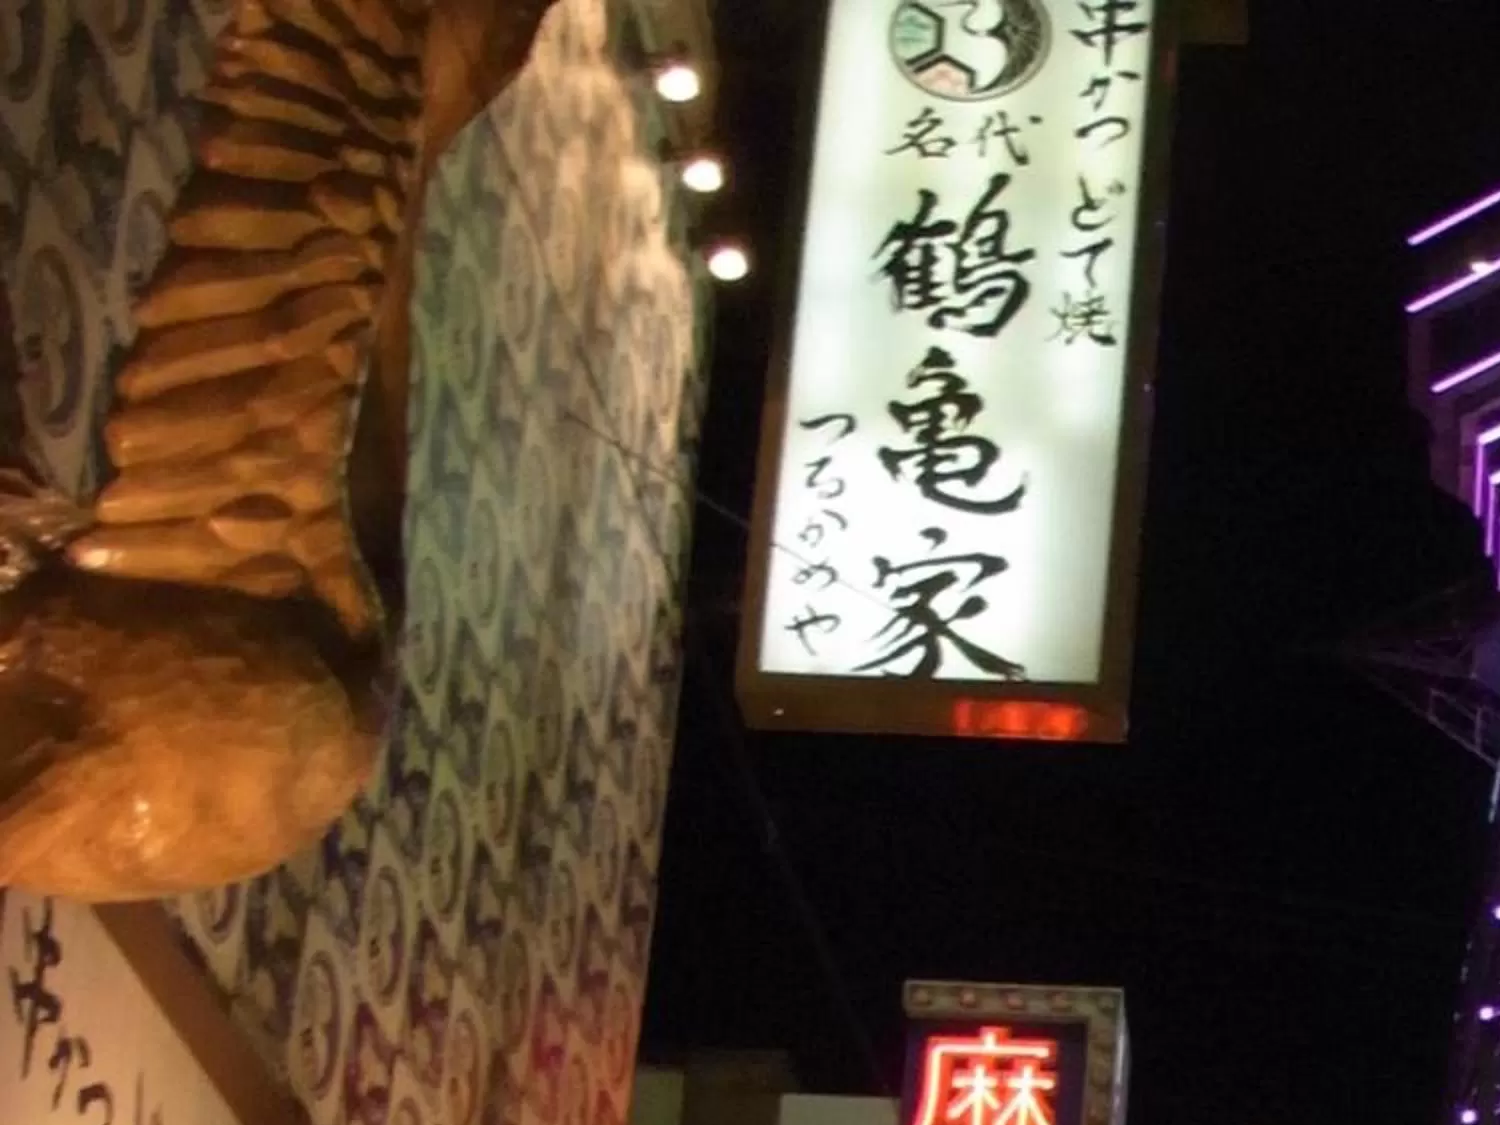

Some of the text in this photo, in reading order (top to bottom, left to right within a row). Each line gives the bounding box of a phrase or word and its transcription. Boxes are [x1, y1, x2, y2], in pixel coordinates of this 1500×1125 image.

[884, 108, 1043, 166] 名代
[784, 411, 858, 657] つるかめや
[852, 172, 1036, 682] 鶴亀家
